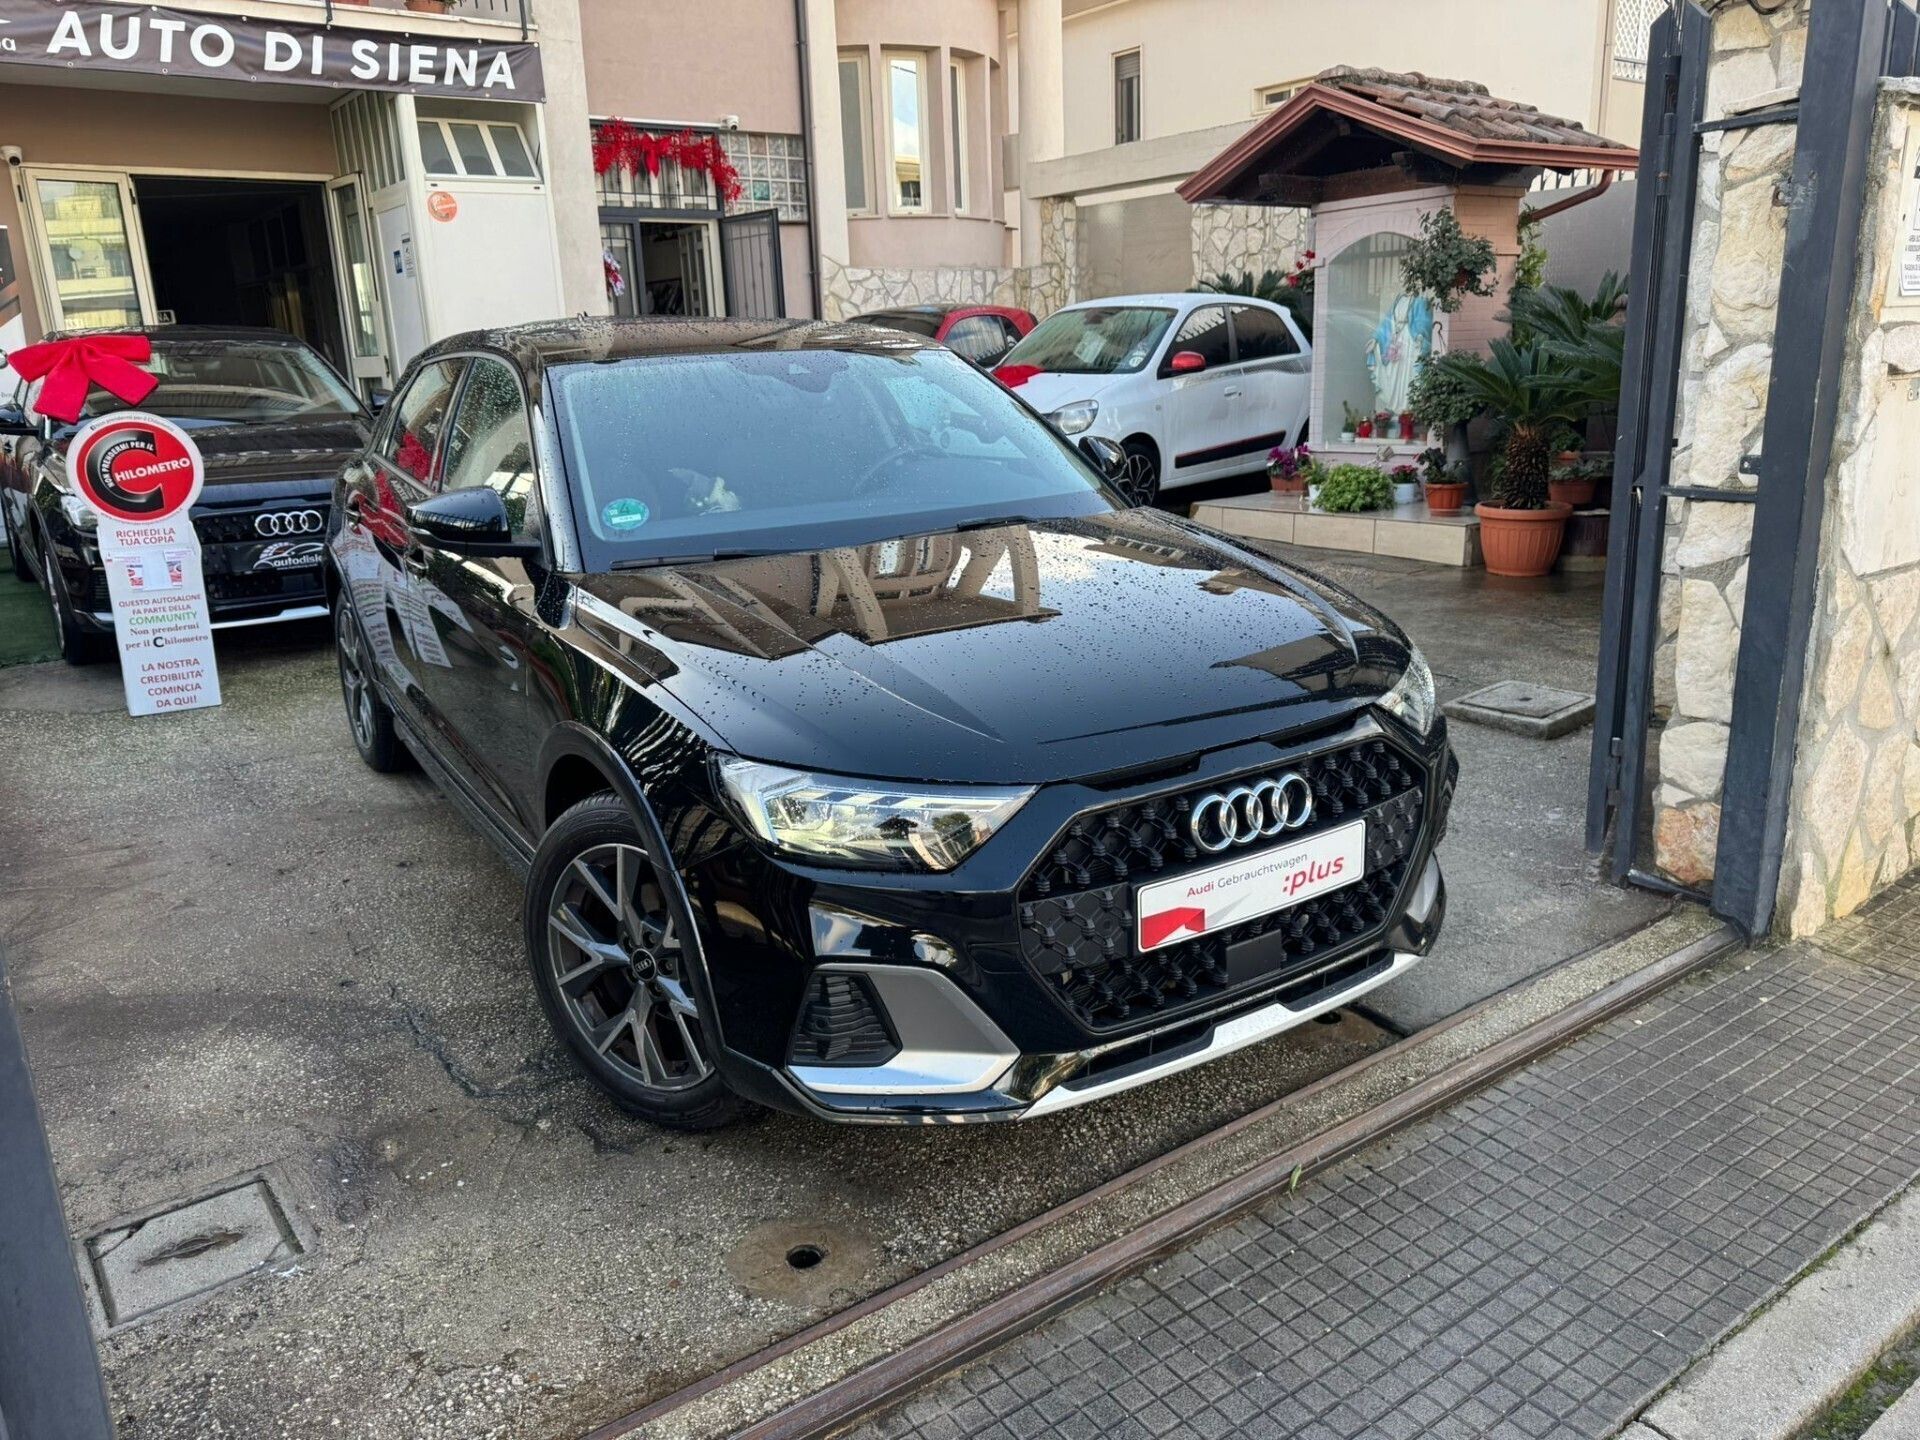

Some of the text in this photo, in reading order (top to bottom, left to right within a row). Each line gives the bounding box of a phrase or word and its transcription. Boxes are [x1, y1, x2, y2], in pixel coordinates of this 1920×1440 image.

[46, 10, 516, 90] AUTO DI SIENA
[130, 441, 146, 449] PER
[116, 527, 176, 538] RICHIEDI LA
[120, 535, 175, 546] TUA COPIA
[119, 594, 201, 608] QUESTO AUTOSALONE
[132, 608, 141, 616] FA
[143, 606, 167, 614] PARTE
[129, 611, 198, 626] COMMUNITY
[130, 622, 199, 636] Non prendermi
[125, 642, 141, 650] per
[153, 635, 209, 648] Chilometro
[141, 658, 200, 672] LA NOSTRA
[147, 683, 202, 696] COMINCIA
[156, 695, 197, 708] DA QUI!
[1186, 852, 1308, 898] Audi Gebrauchtwagen
[1282, 855, 1345, 896] :plus
